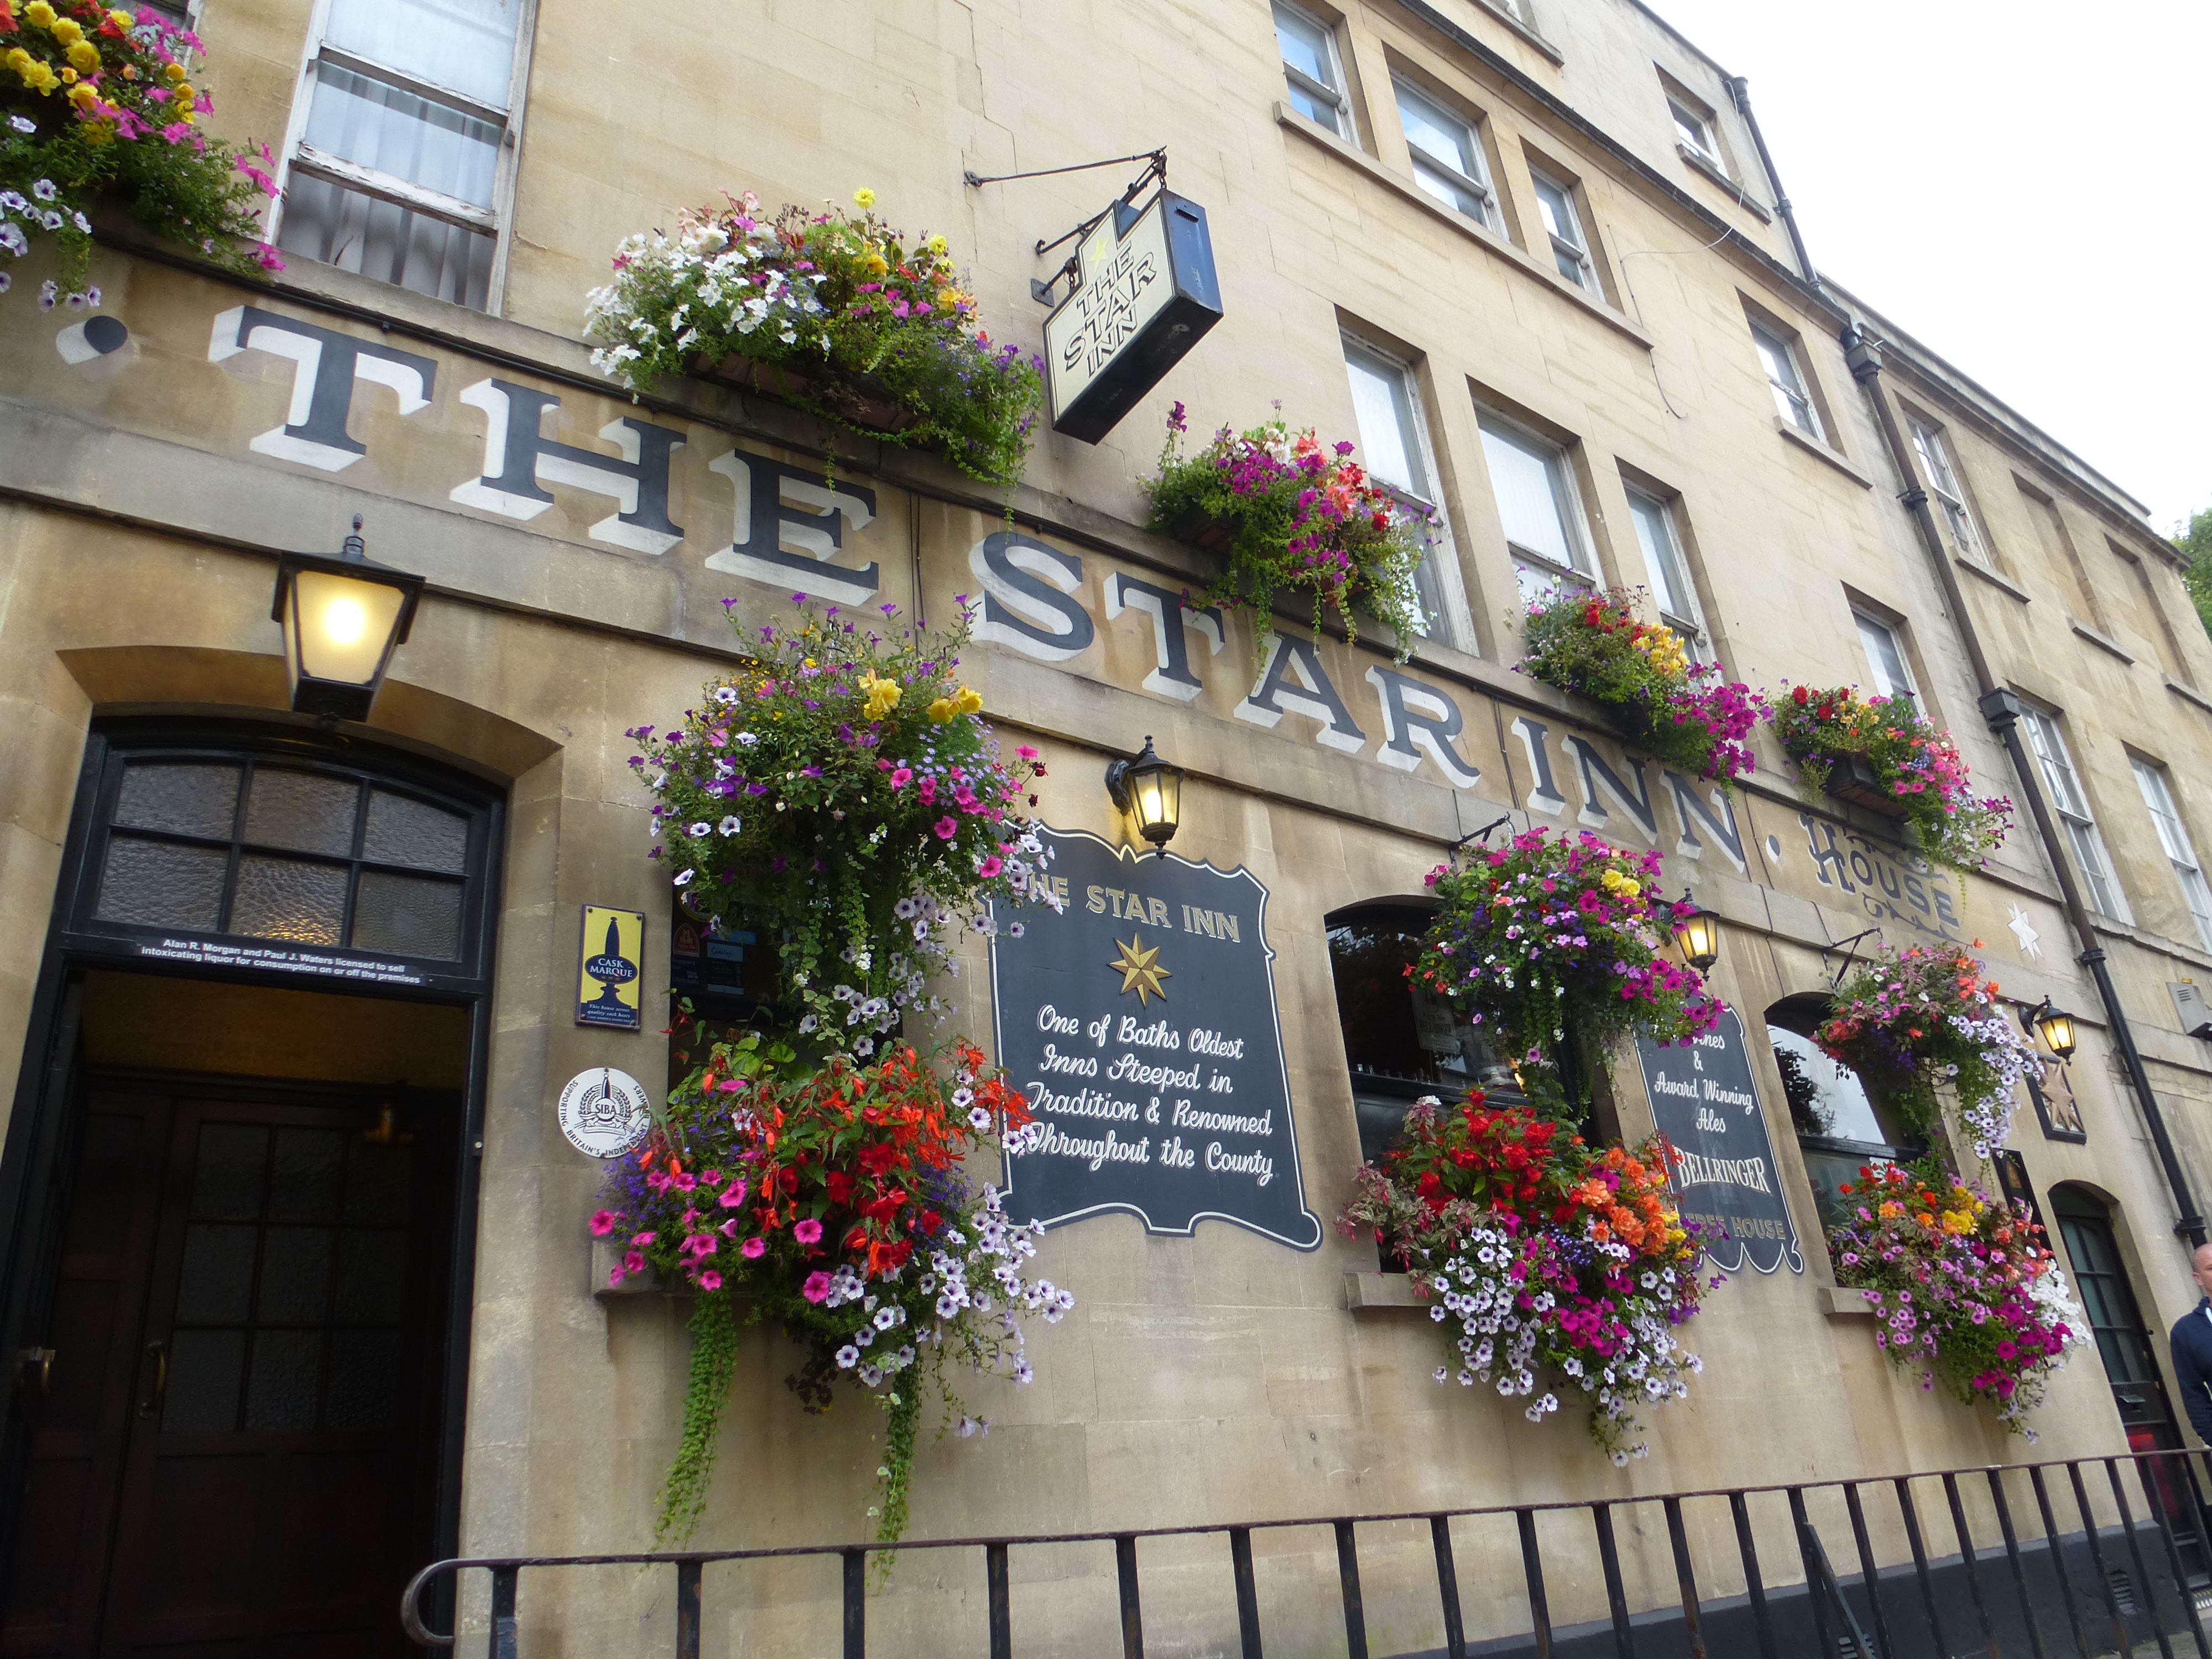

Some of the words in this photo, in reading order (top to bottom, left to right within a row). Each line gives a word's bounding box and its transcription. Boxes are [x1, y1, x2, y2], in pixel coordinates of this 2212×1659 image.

[1076, 241, 1135, 317] THE
[1064, 252, 1157, 372] STAR
[1087, 304, 1138, 378] INN
[209, 305, 879, 607] THE
[968, 531, 1481, 789] STAR
[1510, 716, 1745, 873] INN
[1798, 813, 1959, 929] HOUSE
[1029, 872, 1071, 907] HE
[1086, 885, 1172, 929] STAR
[1182, 904, 1240, 942] INN
[142, 946, 202, 962] intoxicating
[205, 953, 234, 963] liquor
[236, 956, 251, 965] for
[254, 960, 317, 972] consumption
[346, 968, 360, 977] off
[361, 970, 376, 979] the
[378, 973, 421, 984] premises
[163, 939, 187, 949] Alan
[189, 942, 200, 950] R.
[203, 943, 241, 955] Morgan
[264, 950, 286, 959] Paul
[289, 953, 298, 961] J.
[300, 954, 333, 965] Waters
[336, 958, 375, 969] licensed
[590, 965, 633, 978] MARQUE
[598, 958, 624, 968] CASK
[1037, 1004, 1079, 1036] One
[1087, 1014, 1111, 1048] of
[1117, 1015, 1180, 1050] Baths
[1188, 1028, 1244, 1060] Oldest
[1039, 1043, 1098, 1077] Inns
[1107, 1053, 1201, 1093] Steeped
[1208, 1068, 1233, 1094] in
[1693, 1050, 1704, 1071] &
[560, 1079, 578, 1127] SUPPORTING
[595, 1103, 617, 1115] SIBA
[1026, 1082, 1139, 1121] Tradition
[1144, 1096, 1160, 1125] &
[1172, 1099, 1272, 1136] Renowned
[1654, 1071, 1699, 1098] Award
[1703, 1078, 1754, 1115] Winning
[566, 1129, 601, 1155] BRITAIN'S
[1696, 1107, 1726, 1133] Ales
[1027, 1121, 1150, 1171] Throughout
[1159, 1135, 1195, 1169] the
[1205, 1141, 1273, 1186] County
[1672, 1145, 1772, 1194] BELLRINGER
[1730, 1216, 1786, 1240] HOUSE
